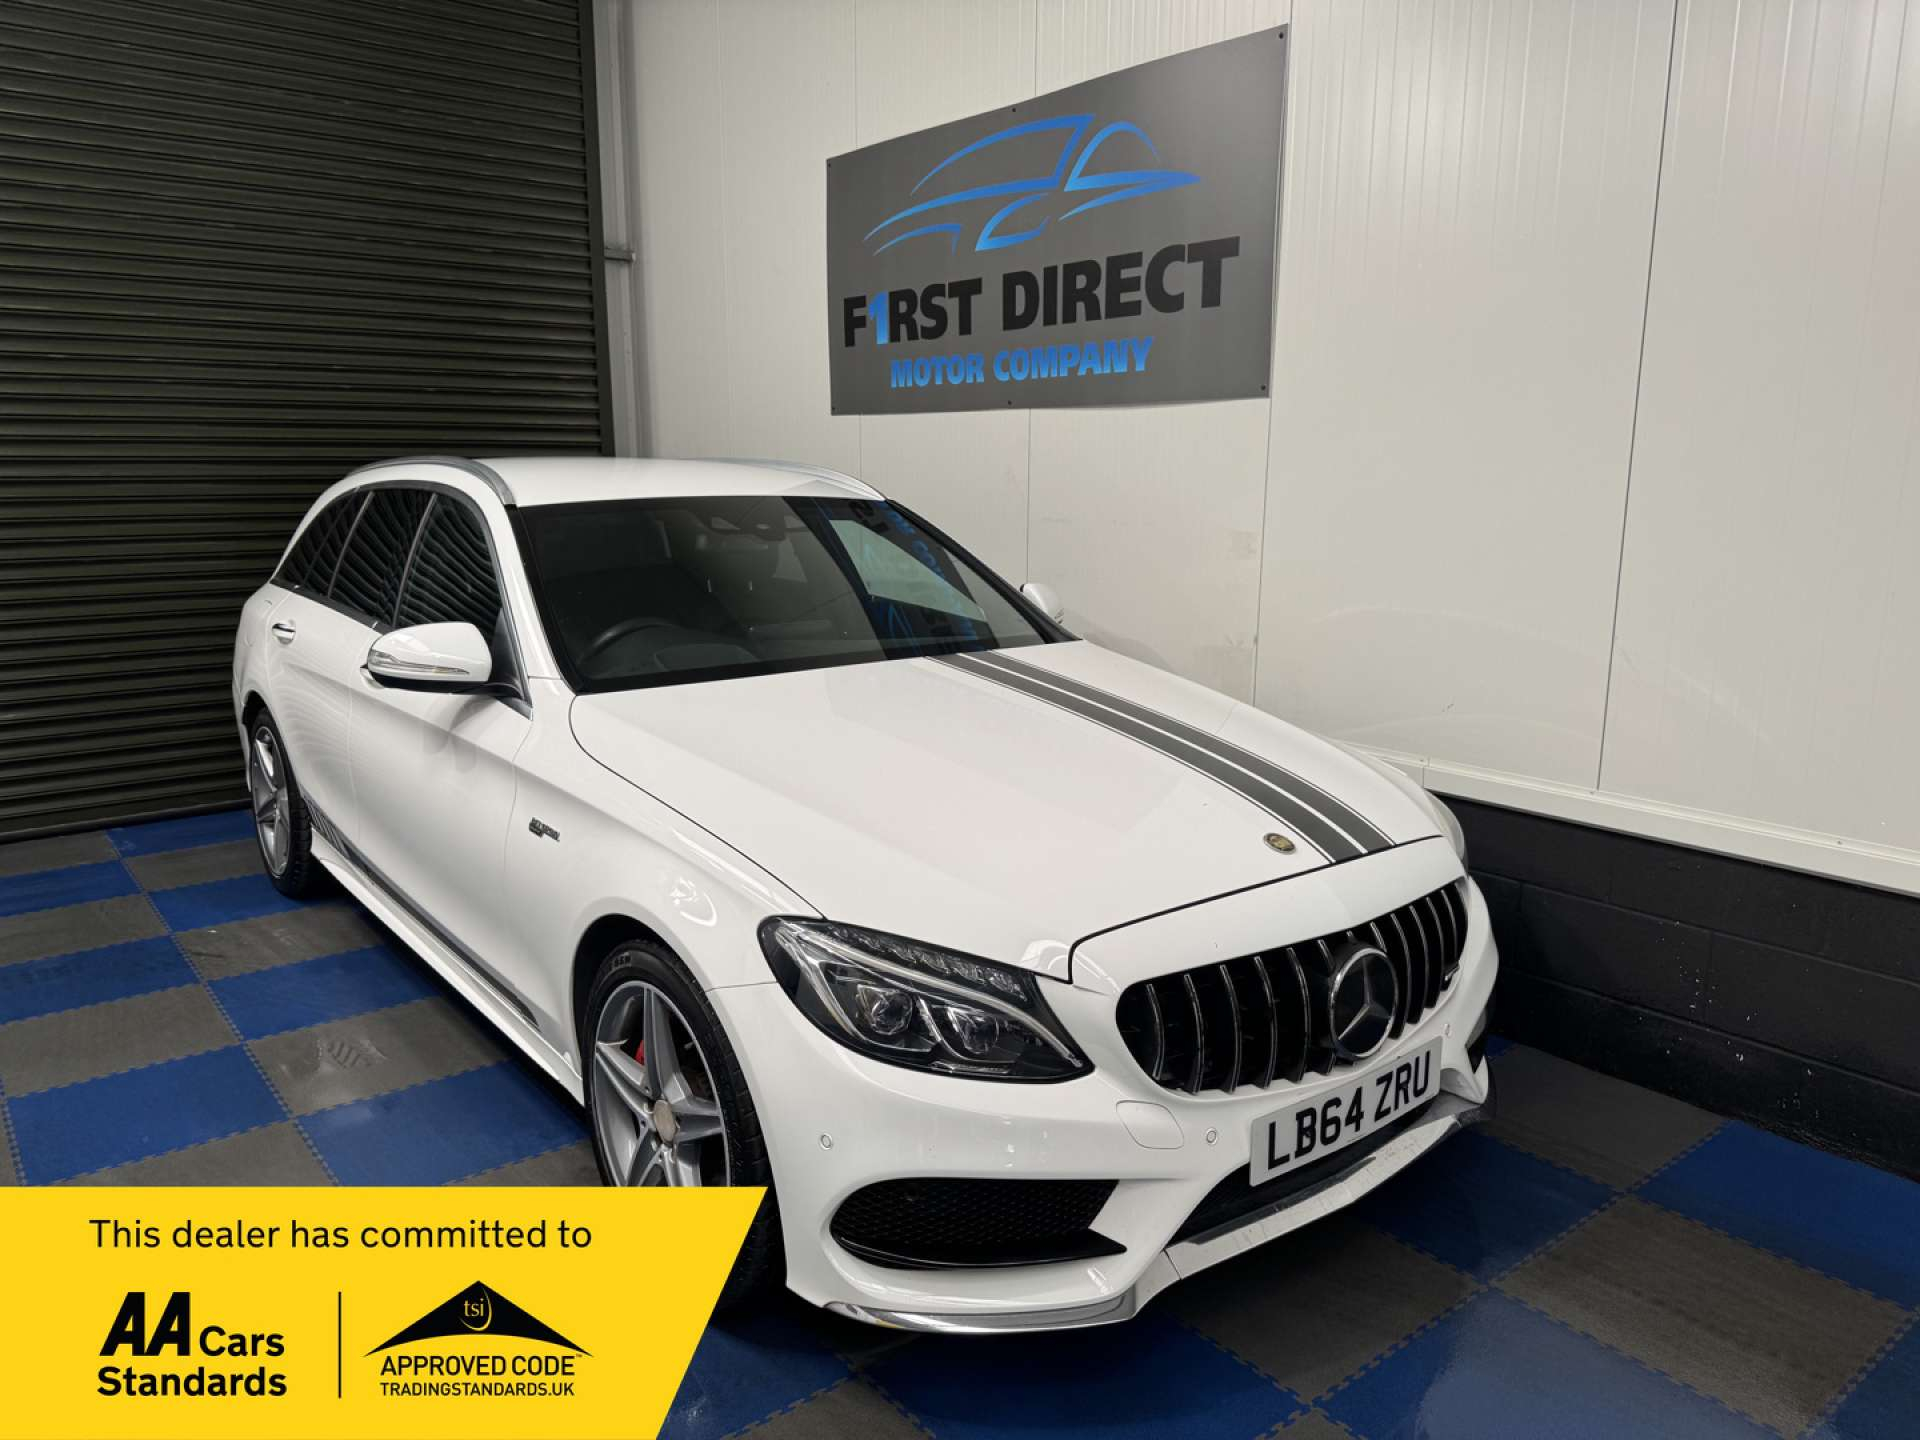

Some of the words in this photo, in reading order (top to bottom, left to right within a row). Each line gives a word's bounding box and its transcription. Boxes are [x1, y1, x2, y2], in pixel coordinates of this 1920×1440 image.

[843, 277, 983, 348] F1RST
[1002, 235, 1241, 332] DIRECT
[890, 352, 985, 389] MOTOR
[993, 335, 1154, 382] COMPANY
[1267, 1086, 1365, 1170] LB64
[1374, 1050, 1431, 1123] ZRU
